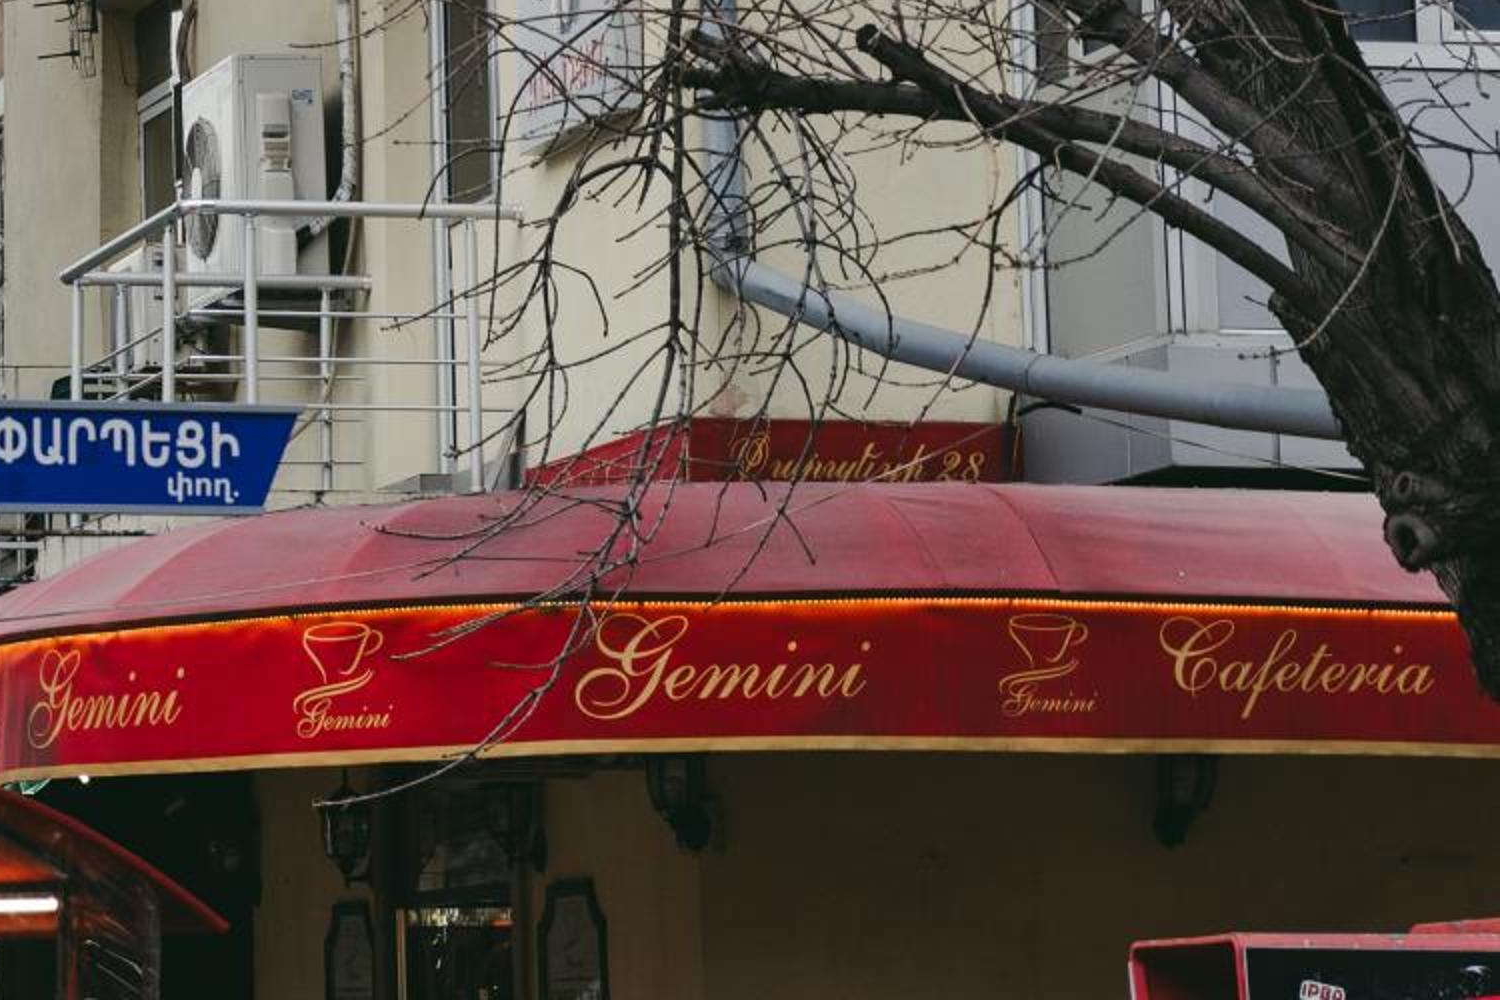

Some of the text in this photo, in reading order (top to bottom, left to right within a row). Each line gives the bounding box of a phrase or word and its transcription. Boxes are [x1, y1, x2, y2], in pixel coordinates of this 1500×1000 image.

[167, 471, 240, 504] փող.
[936, 450, 986, 483] 28
[574, 611, 873, 721] Gemini
[1158, 615, 1435, 720] Cafeteria
[27, 648, 186, 750] Gemini
[296, 696, 394, 740] Gemini
[999, 680, 1098, 719] Gemini
